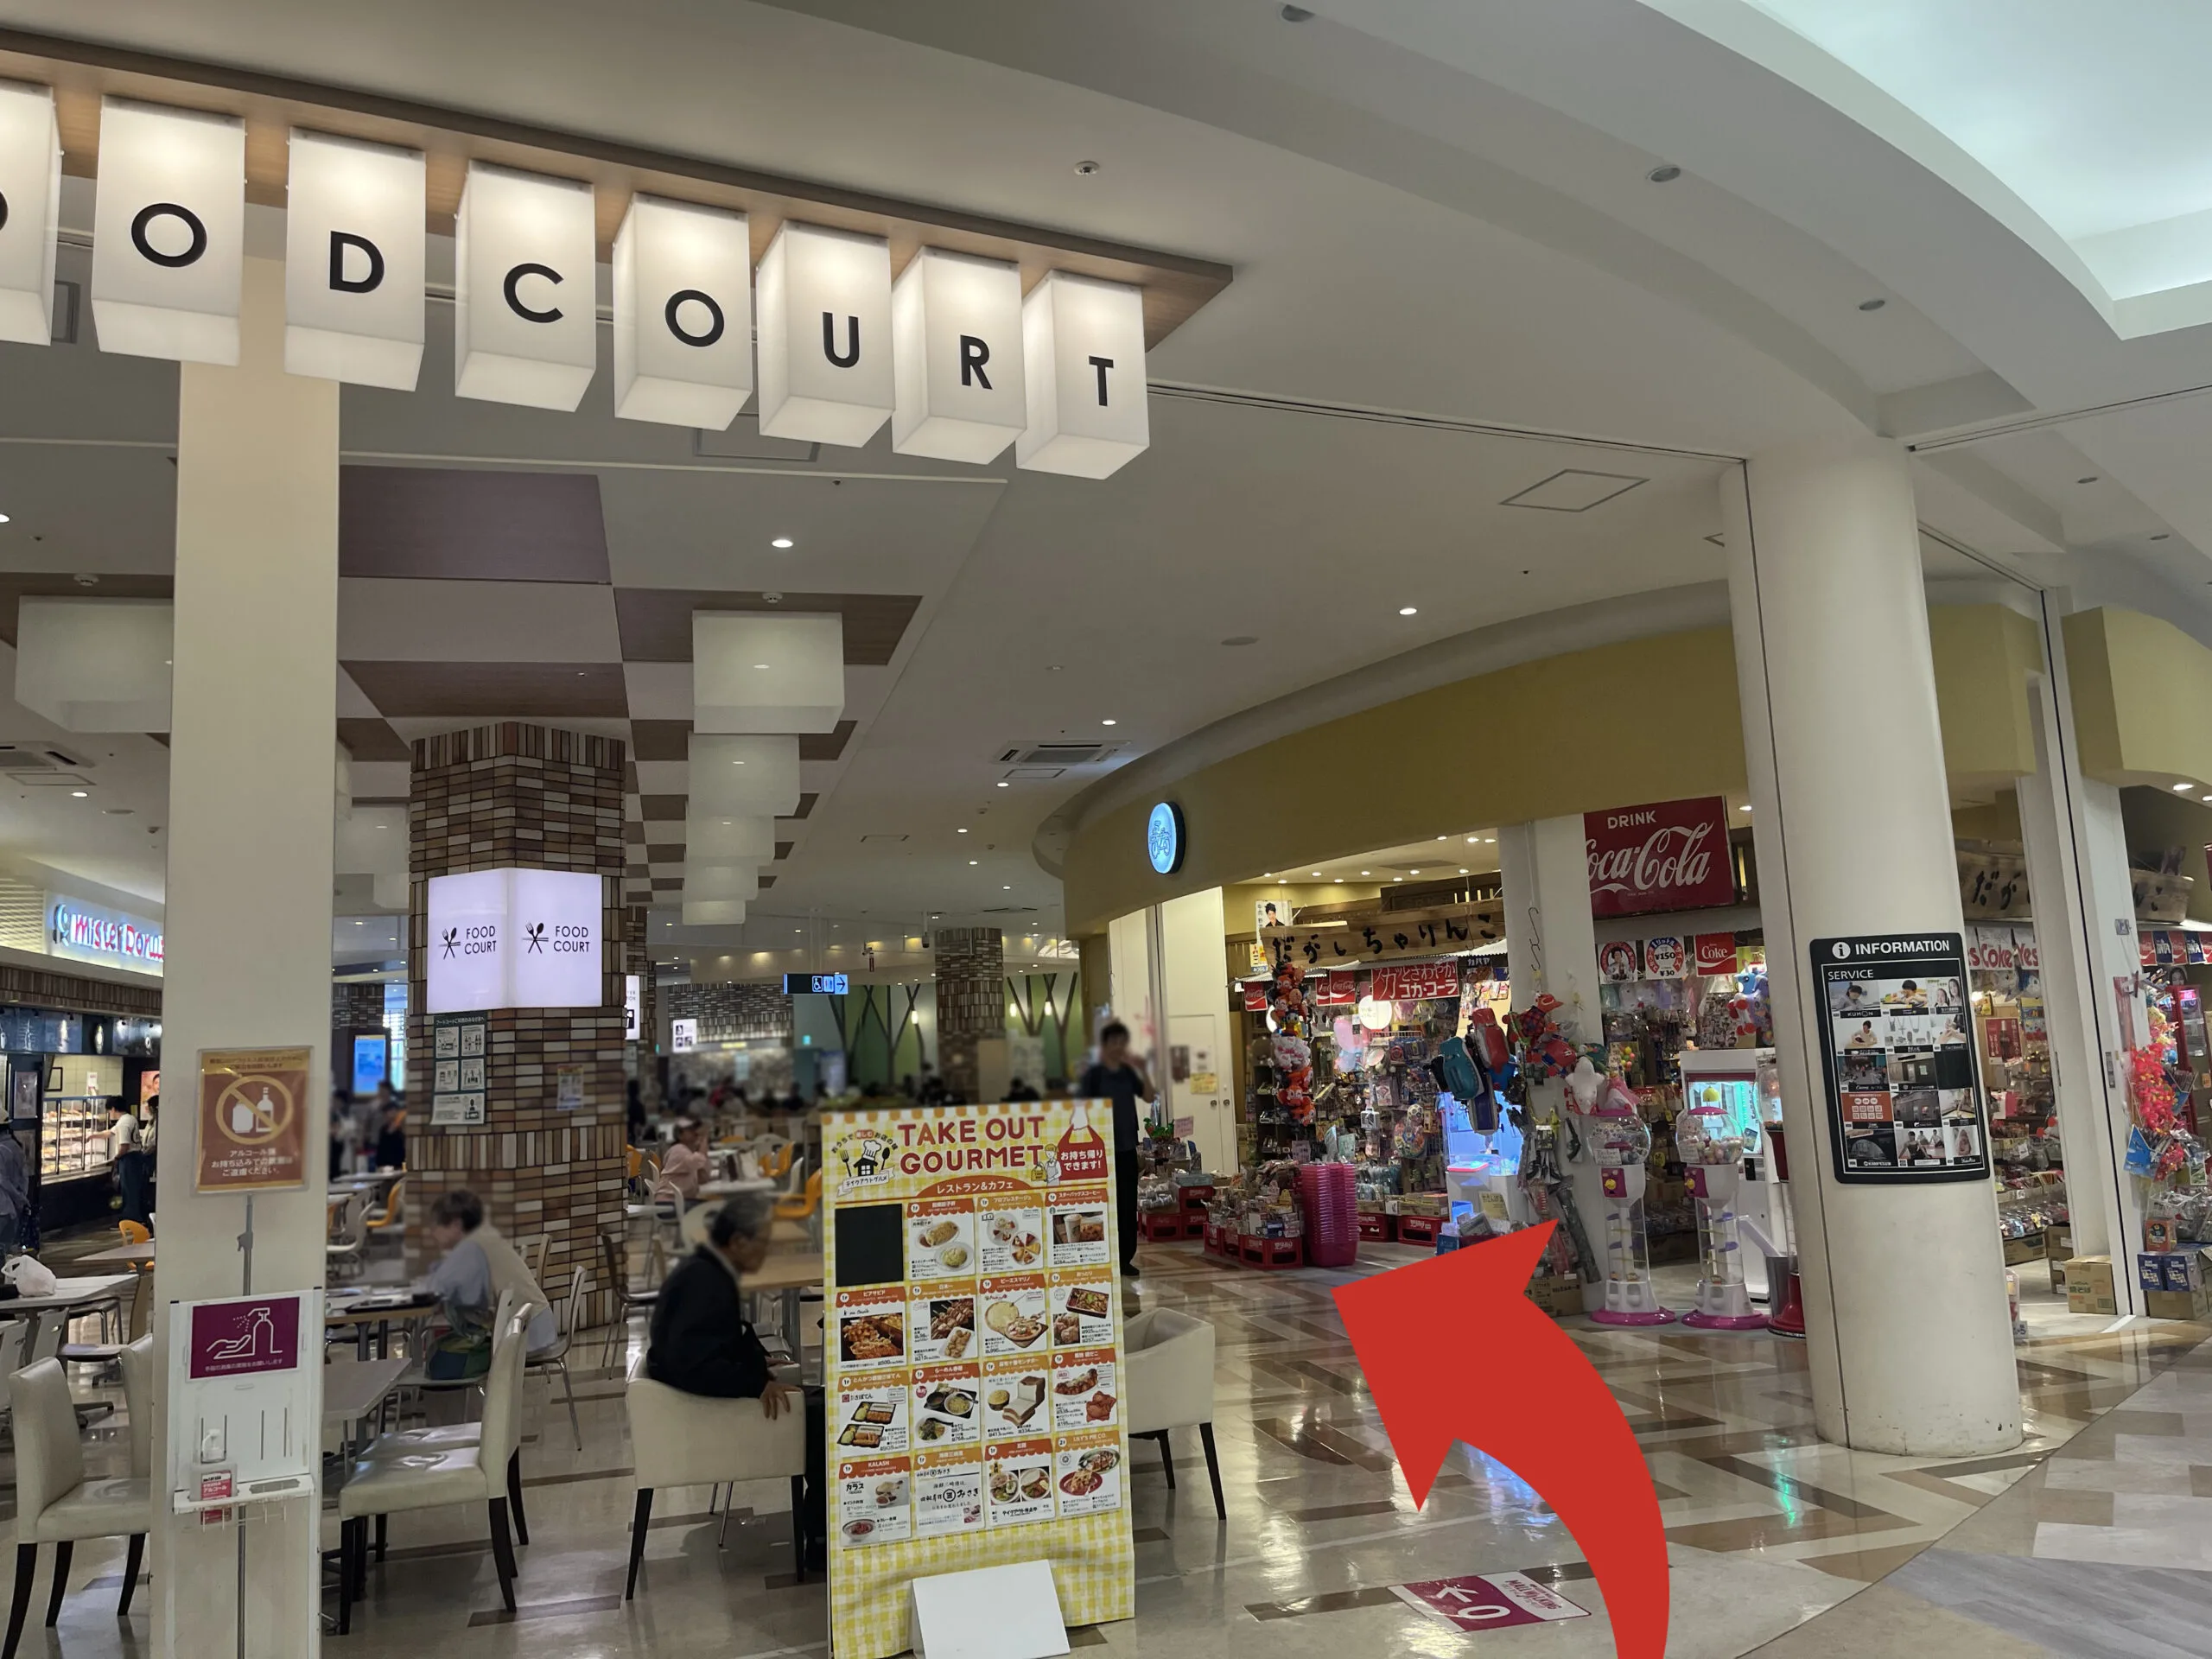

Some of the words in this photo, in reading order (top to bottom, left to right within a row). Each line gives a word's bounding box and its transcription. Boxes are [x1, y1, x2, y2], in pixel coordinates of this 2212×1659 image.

[1607, 810, 1656, 830] DRINK
[466, 925, 496, 940] FOOD
[555, 925, 589, 938] FOOD
[464, 940, 497, 955] COURT
[553, 940, 590, 954] COURT
[1701, 945, 1728, 959] Coke
[1855, 940, 1950, 956] INFORMATION
[1981, 944, 2012, 968] Coke
[1827, 969, 1874, 980] SERVICE
[1399, 979, 1458, 998] コカ・コーラ
[898, 1119, 976, 1147] TAKE
[986, 1116, 1046, 1140] OUT
[900, 1145, 1045, 1175] GOURMET
[1060, 1149, 1103, 1161] お持ち帰り
[937, 1181, 1014, 1194] レストラン&カフェ
